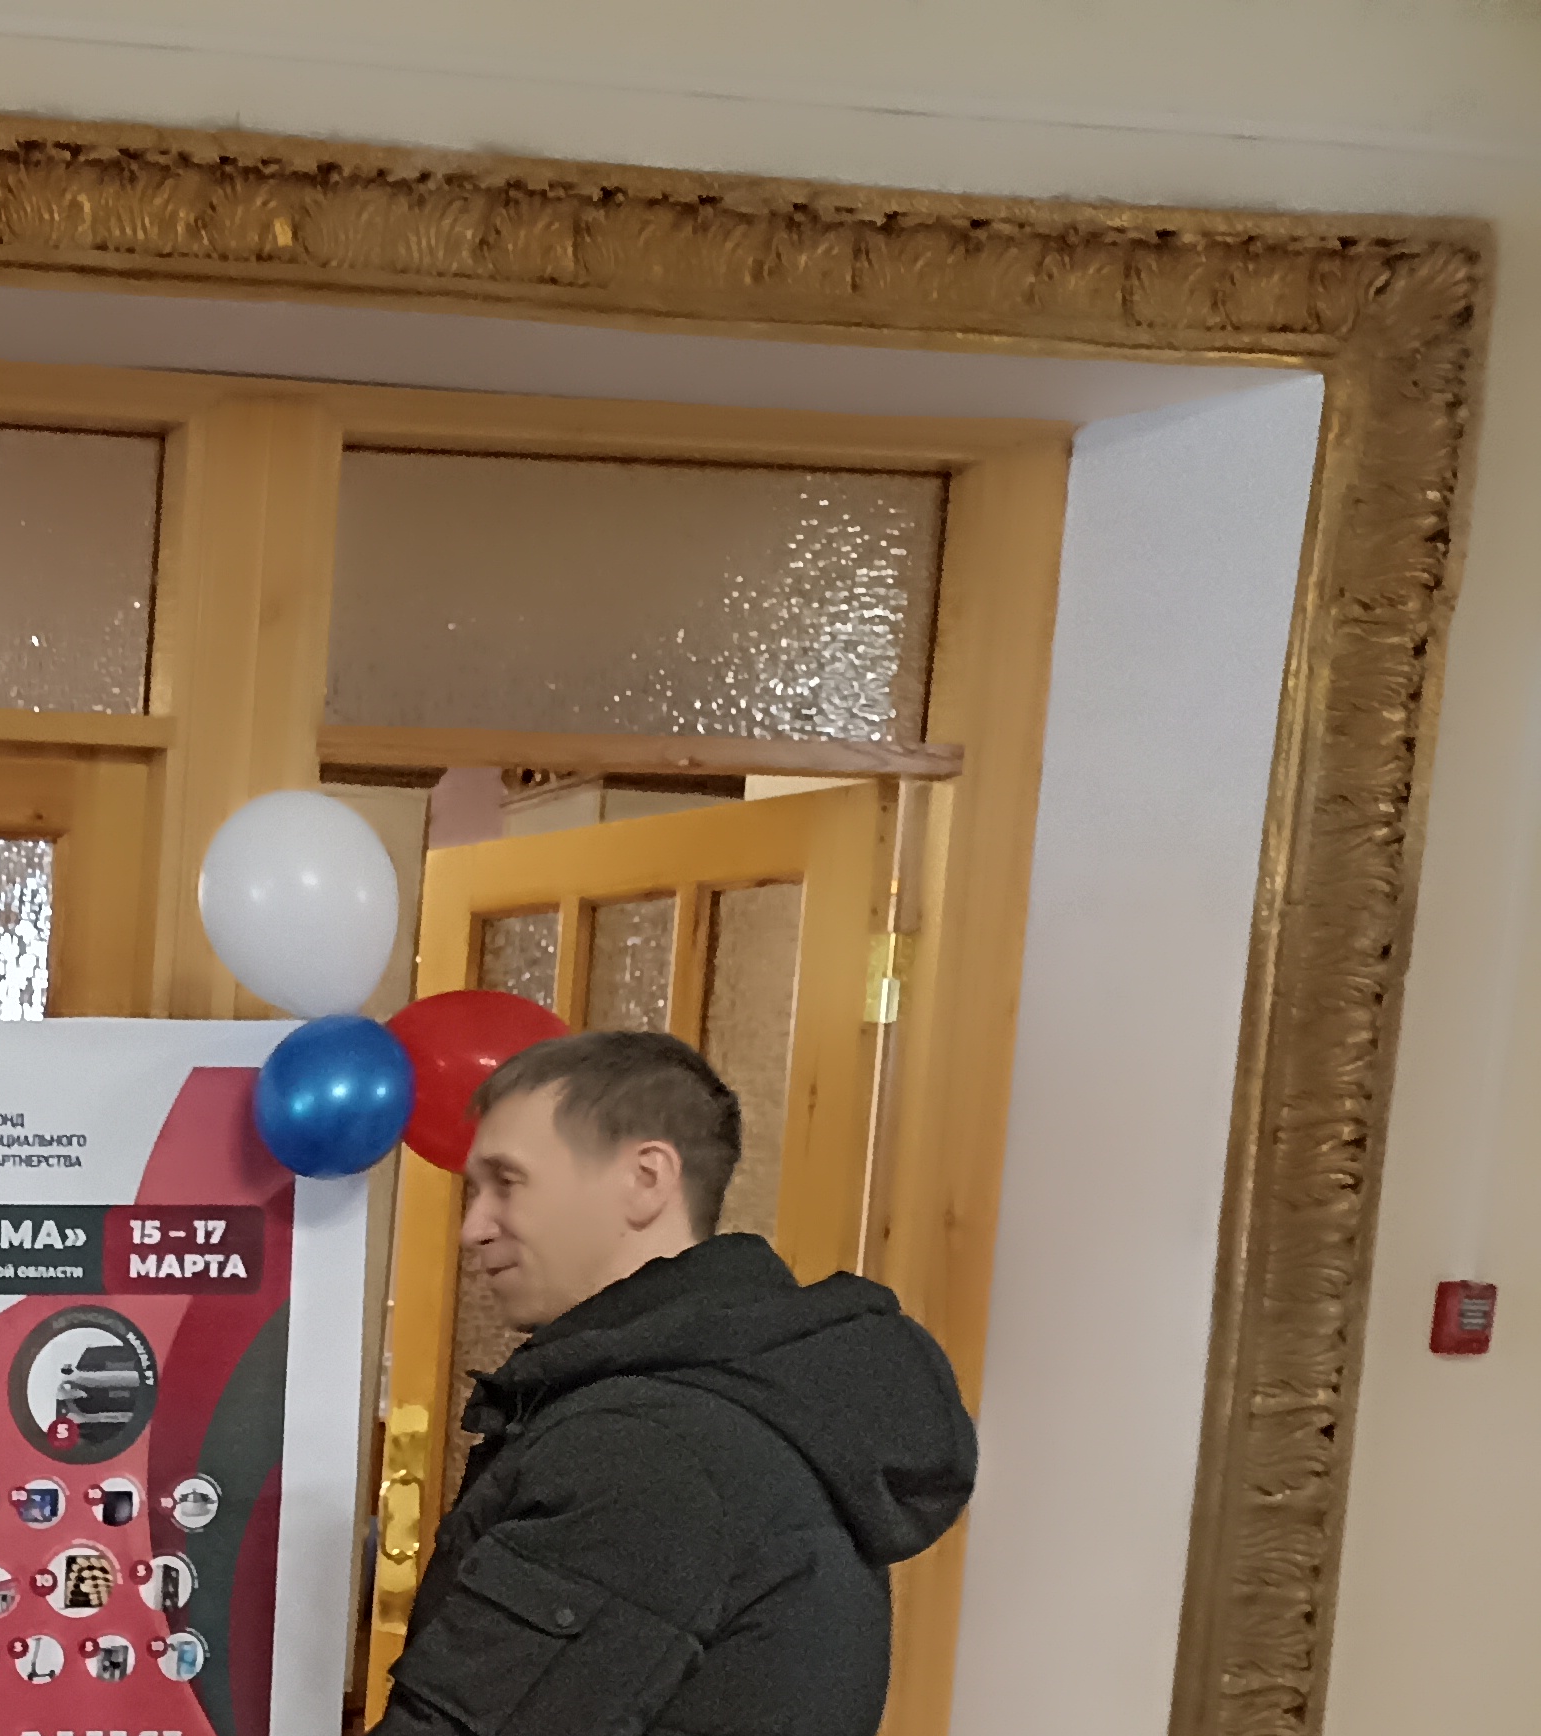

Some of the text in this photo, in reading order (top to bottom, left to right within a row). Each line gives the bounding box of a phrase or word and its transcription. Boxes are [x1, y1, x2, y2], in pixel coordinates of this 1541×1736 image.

[129, 1220, 161, 1245] 15
[192, 1220, 227, 1245] 17
[16, 1266, 84, 1279] ОБЛАСТИ
[129, 1253, 248, 1279] МАРТА
